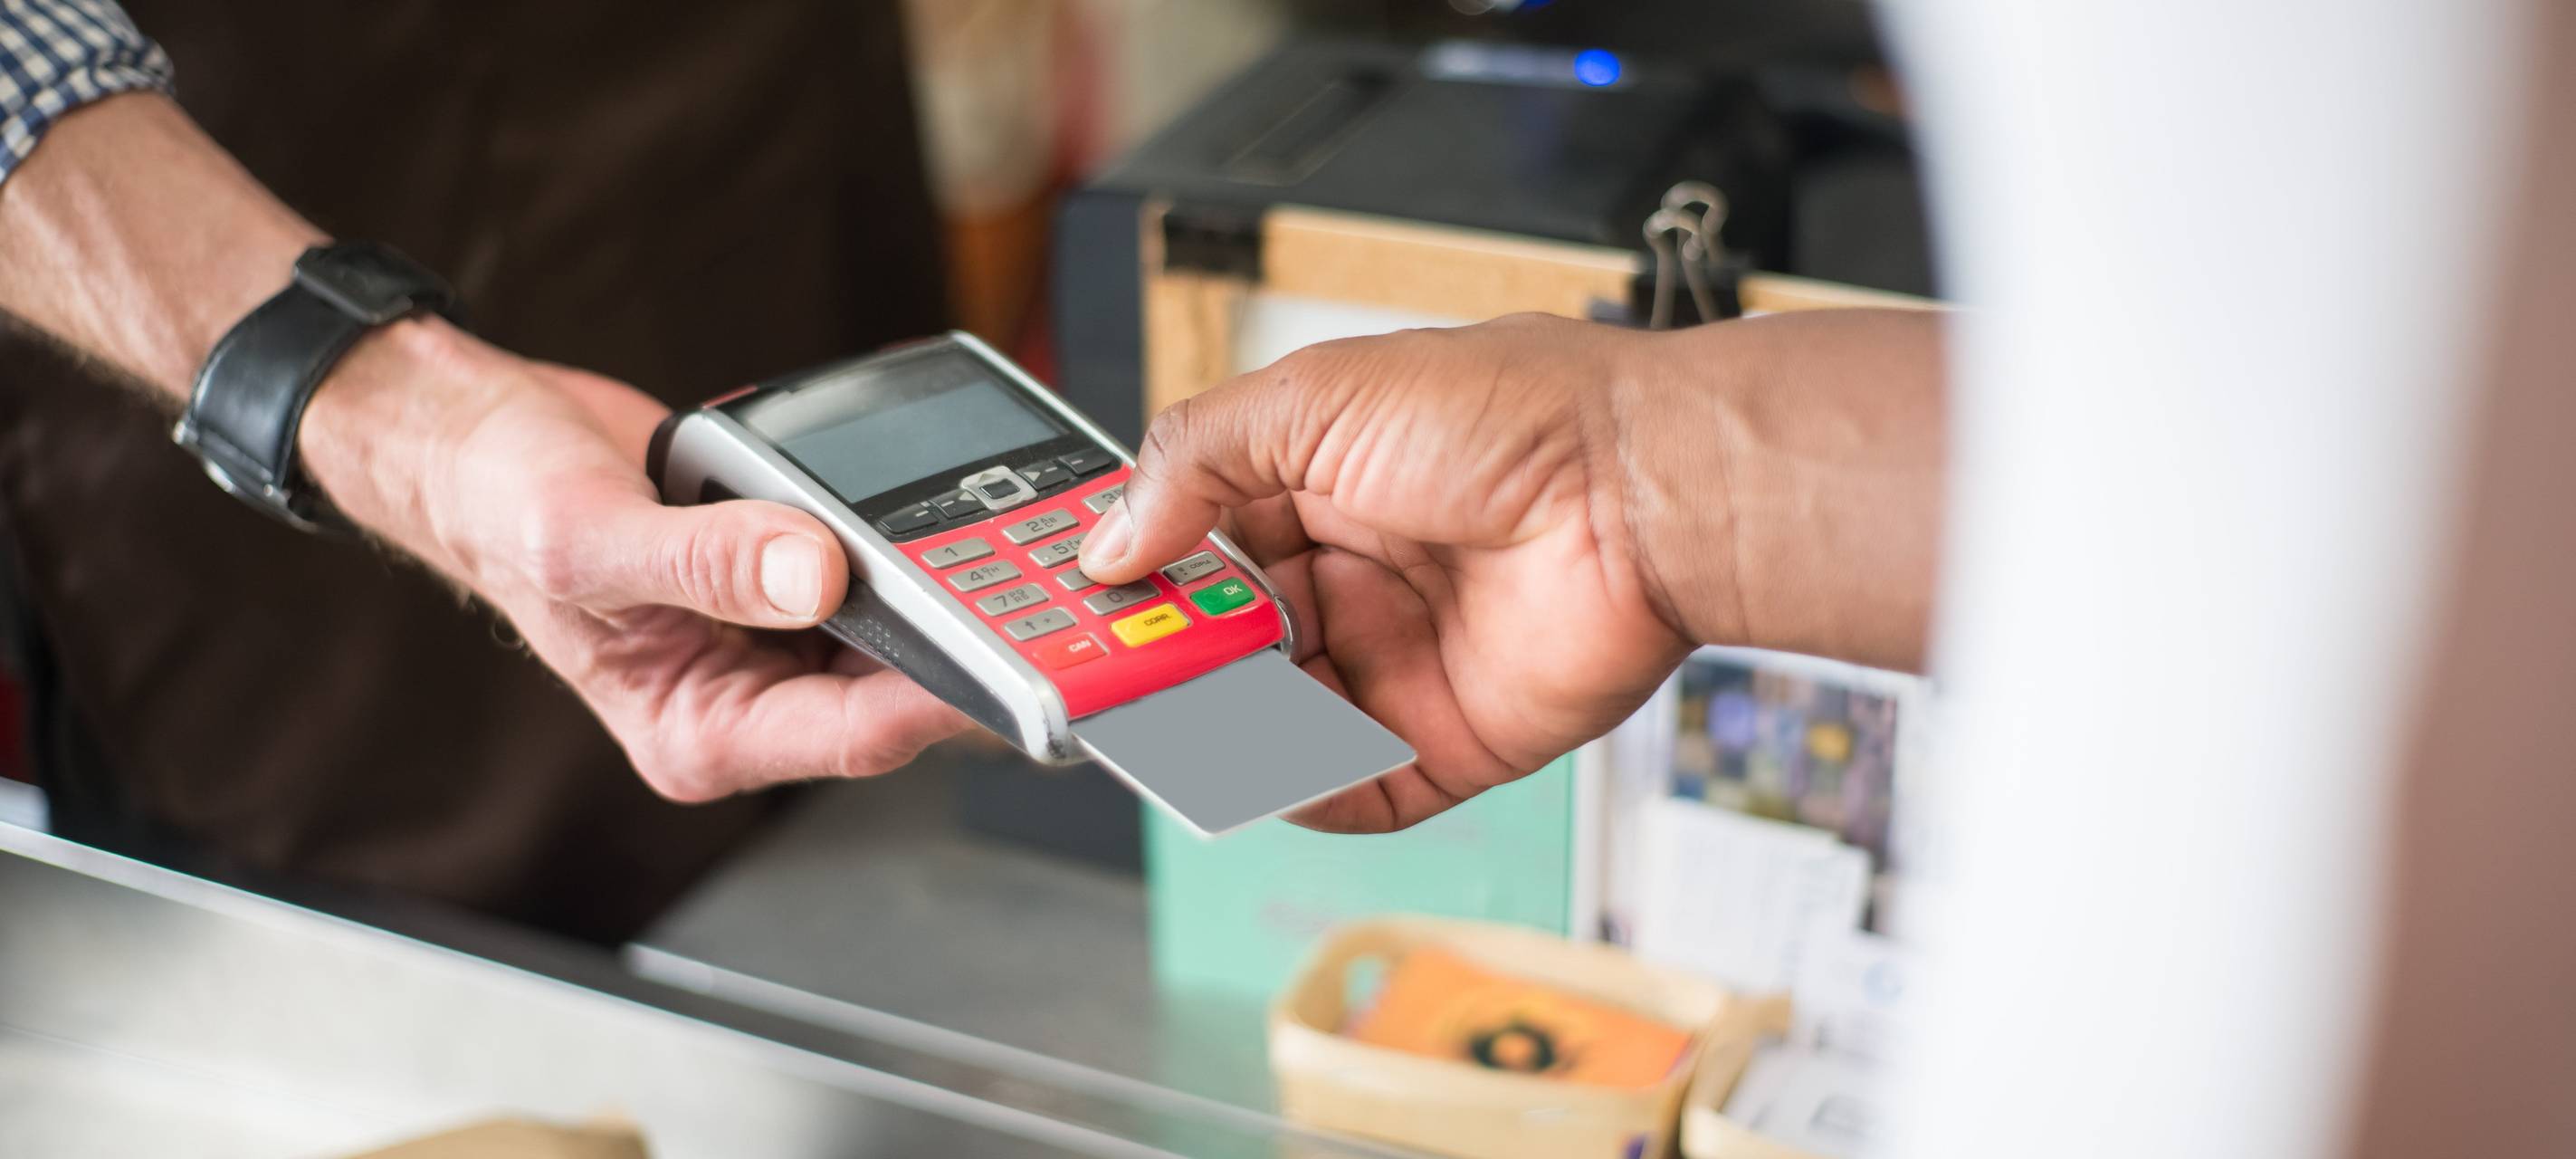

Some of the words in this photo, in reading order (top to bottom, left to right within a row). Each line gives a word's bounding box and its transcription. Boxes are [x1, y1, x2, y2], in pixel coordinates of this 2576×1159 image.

[1026, 521, 1044, 532] 2
[945, 546, 959, 557] 1
[1052, 542, 1069, 554] 5
[970, 570, 985, 581] 4
[1223, 584, 1243, 595] OK
[993, 594, 1007, 608] 7
